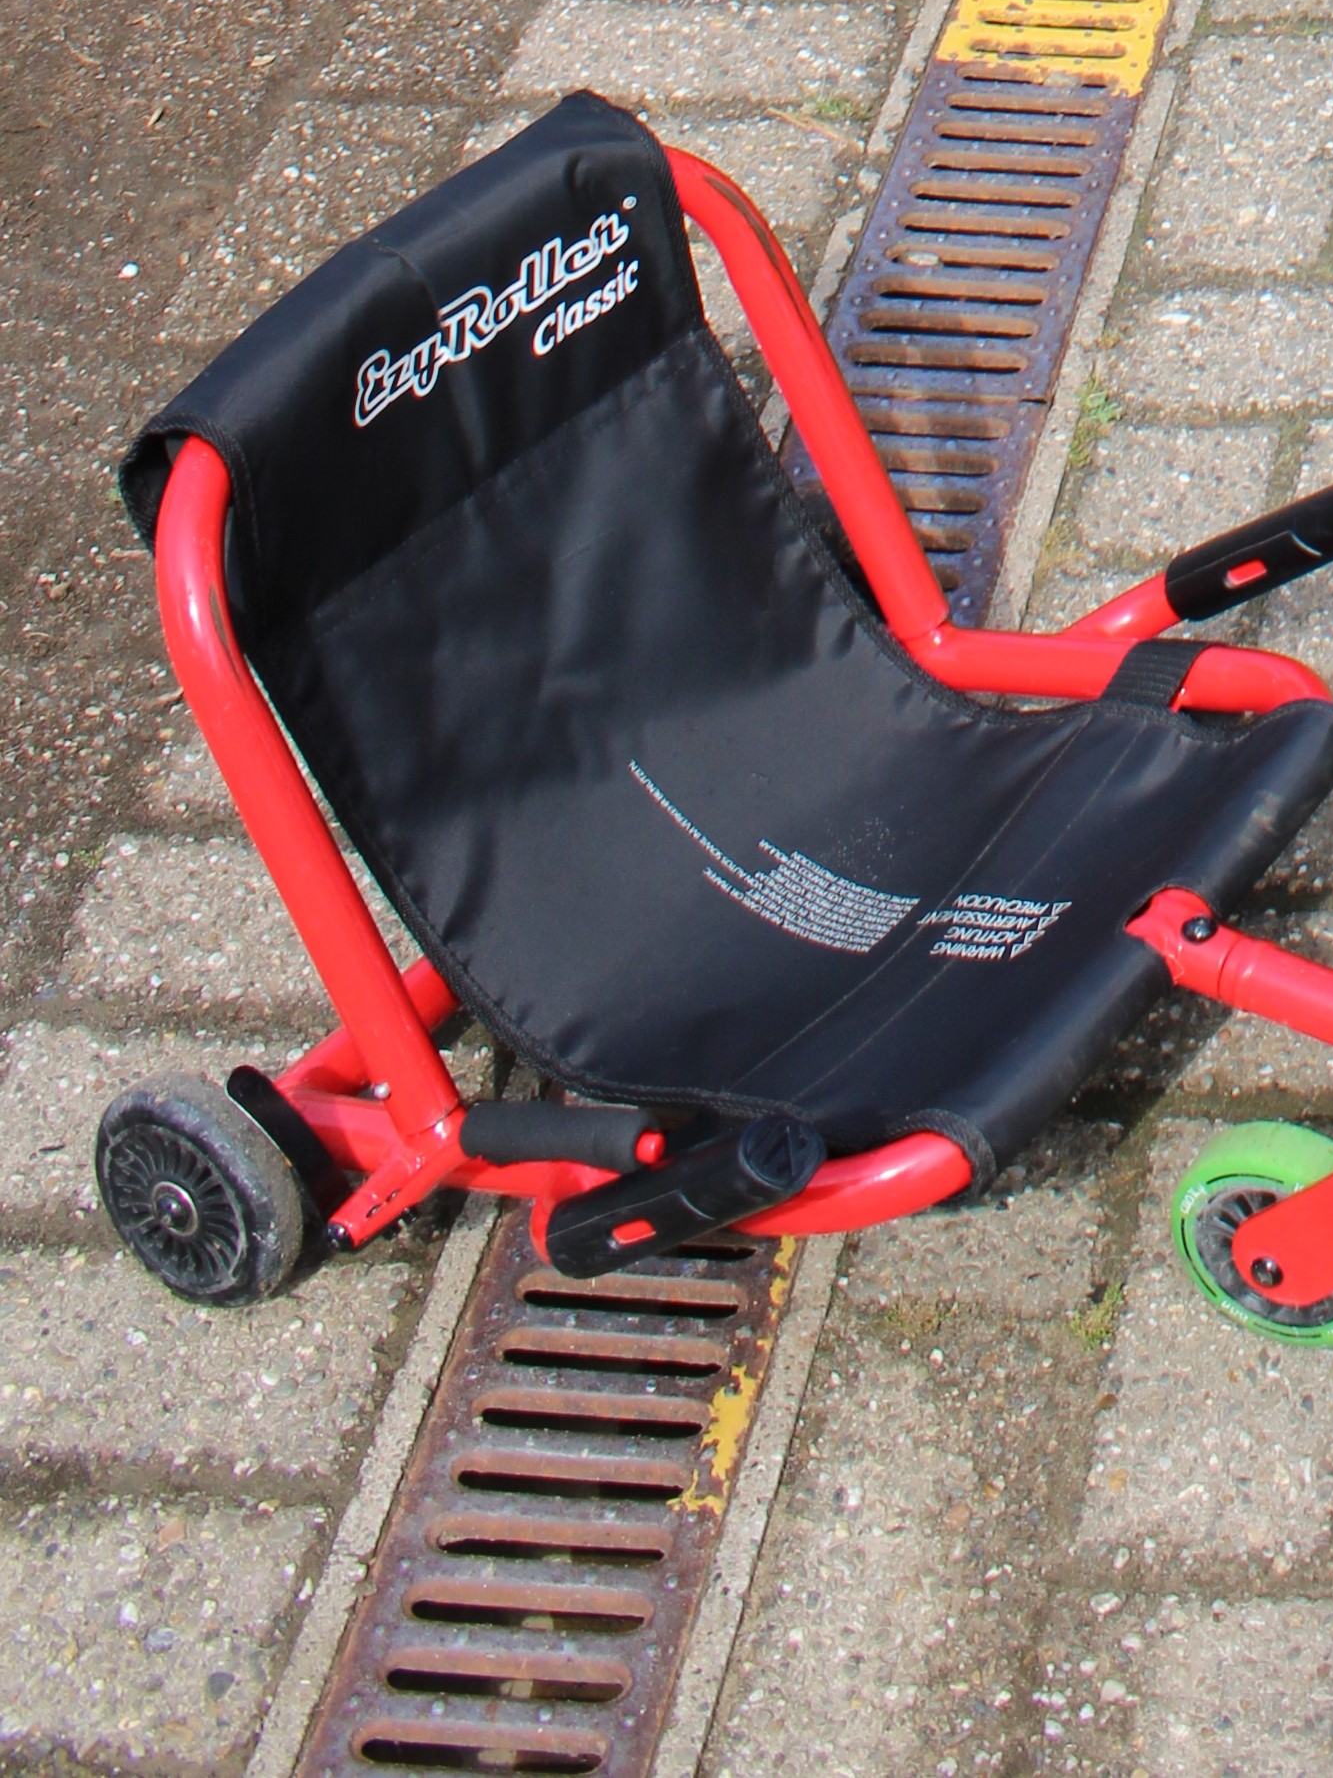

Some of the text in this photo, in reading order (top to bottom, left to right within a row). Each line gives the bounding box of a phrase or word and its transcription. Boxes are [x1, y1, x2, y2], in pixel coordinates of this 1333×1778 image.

[352, 207, 632, 427] EzyRoller
[532, 260, 640, 357] Classic
[917, 910, 1038, 930] AVERTISSEMENT
[944, 926, 1024, 944] ACHTUNG
[929, 941, 1006, 960] WARNING
